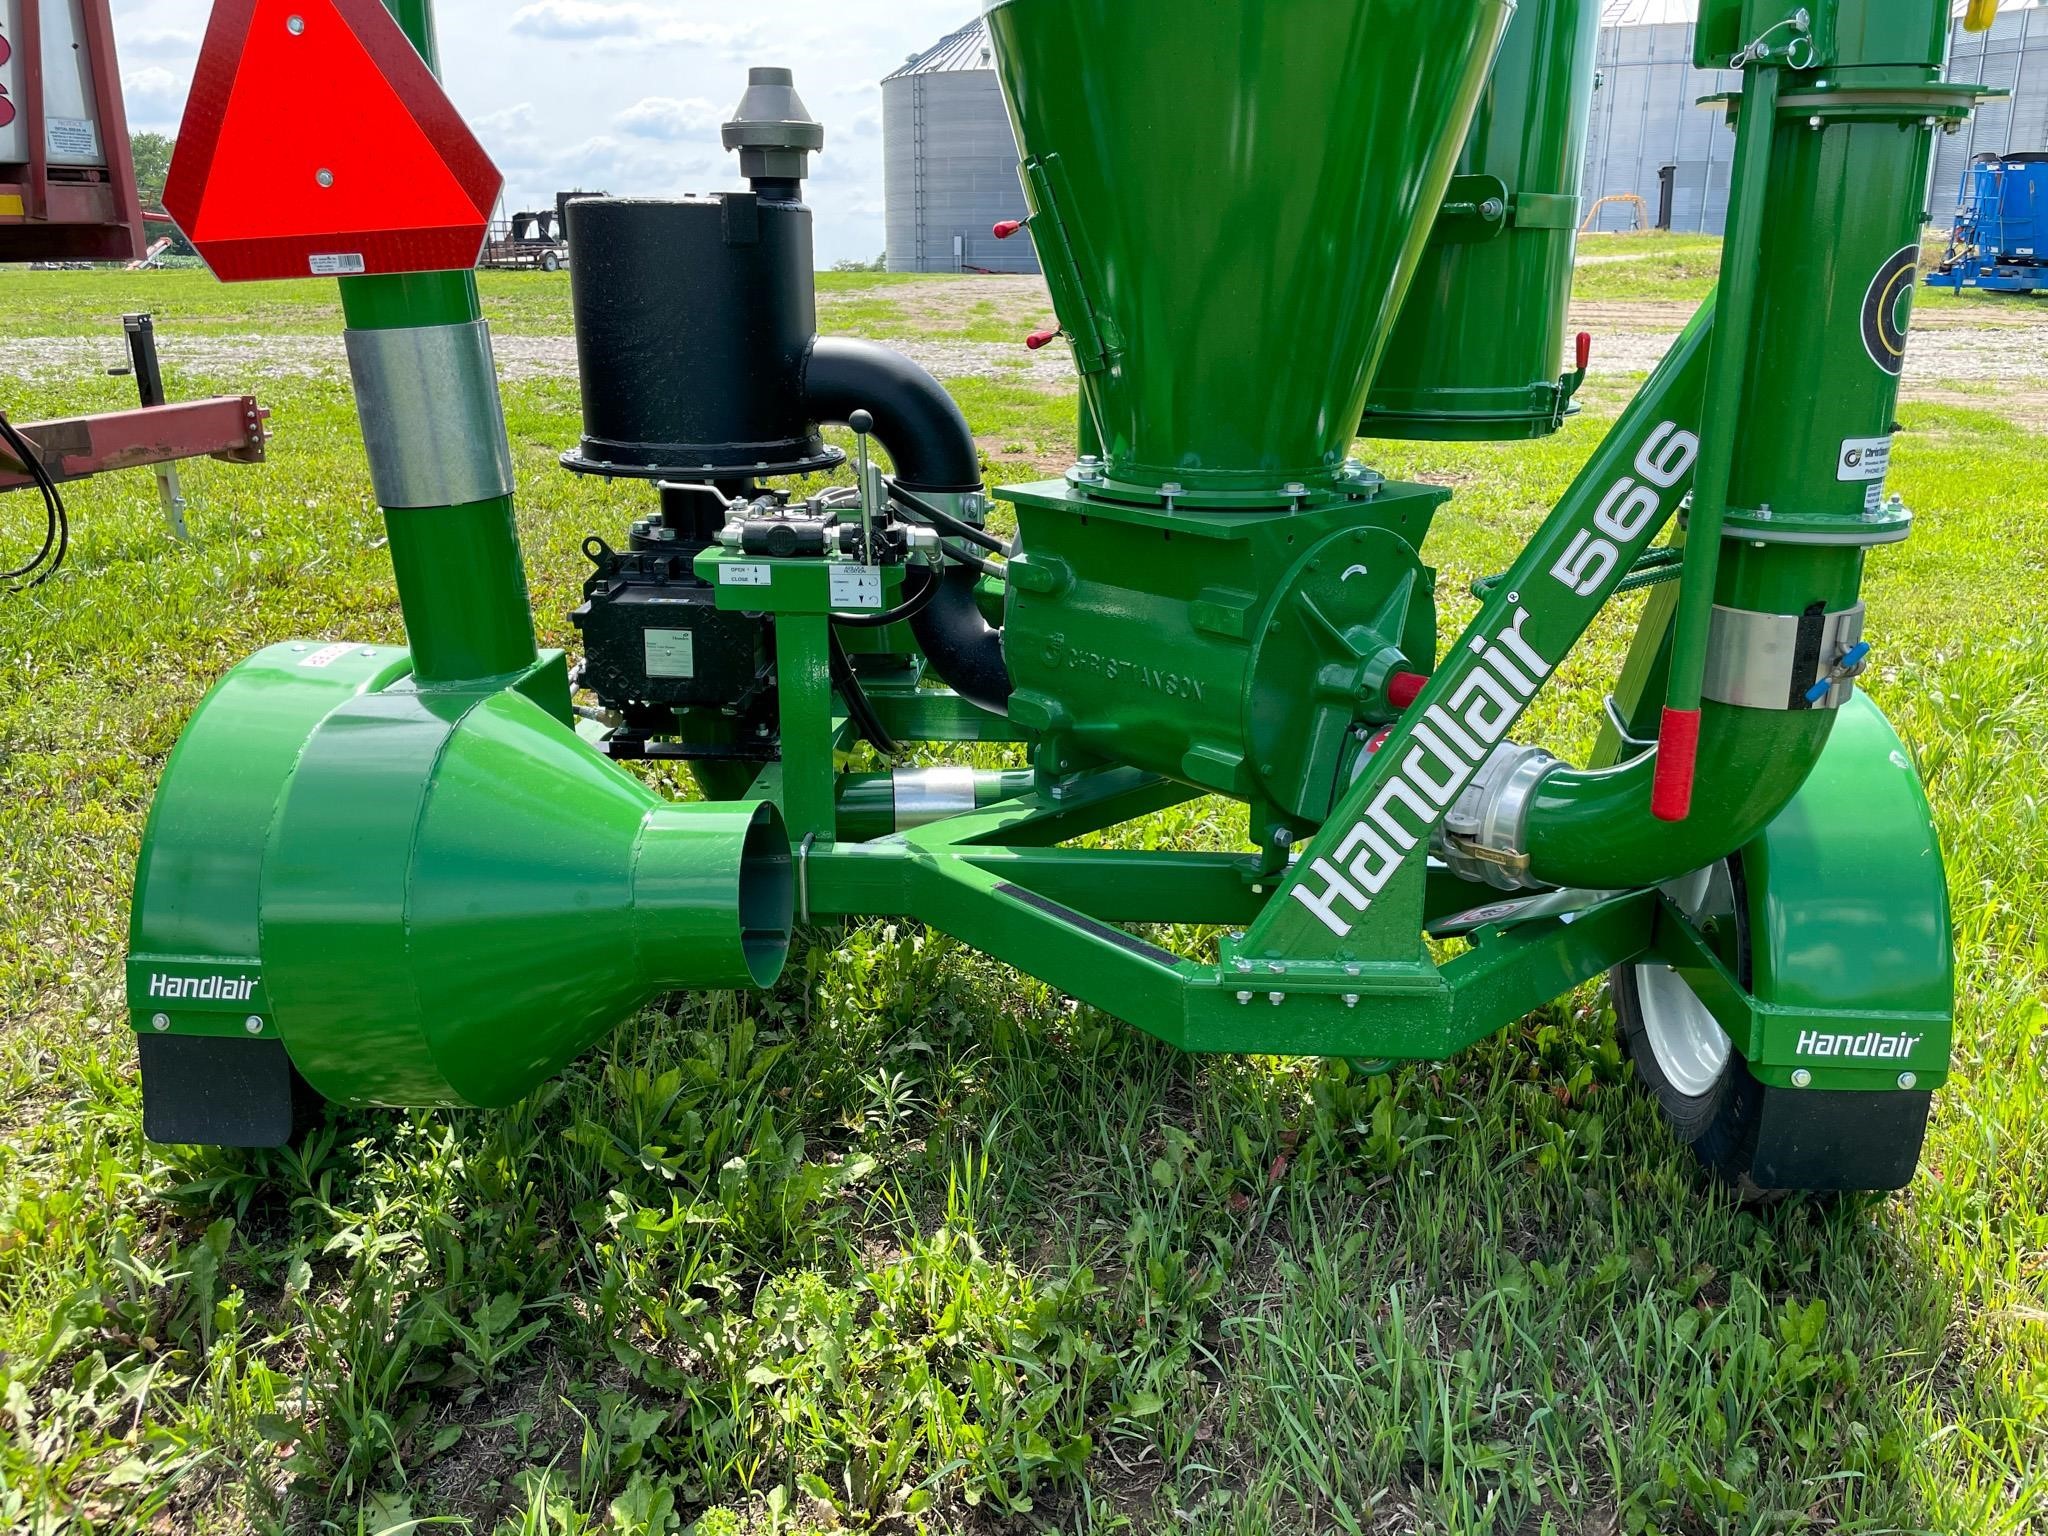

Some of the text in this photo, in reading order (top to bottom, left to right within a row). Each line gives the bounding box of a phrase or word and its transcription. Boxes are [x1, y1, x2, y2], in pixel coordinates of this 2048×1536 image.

[1549, 420, 1699, 597] 566
[149, 973, 259, 1000] Handlair
[1795, 1030, 1920, 1058] Handlair
